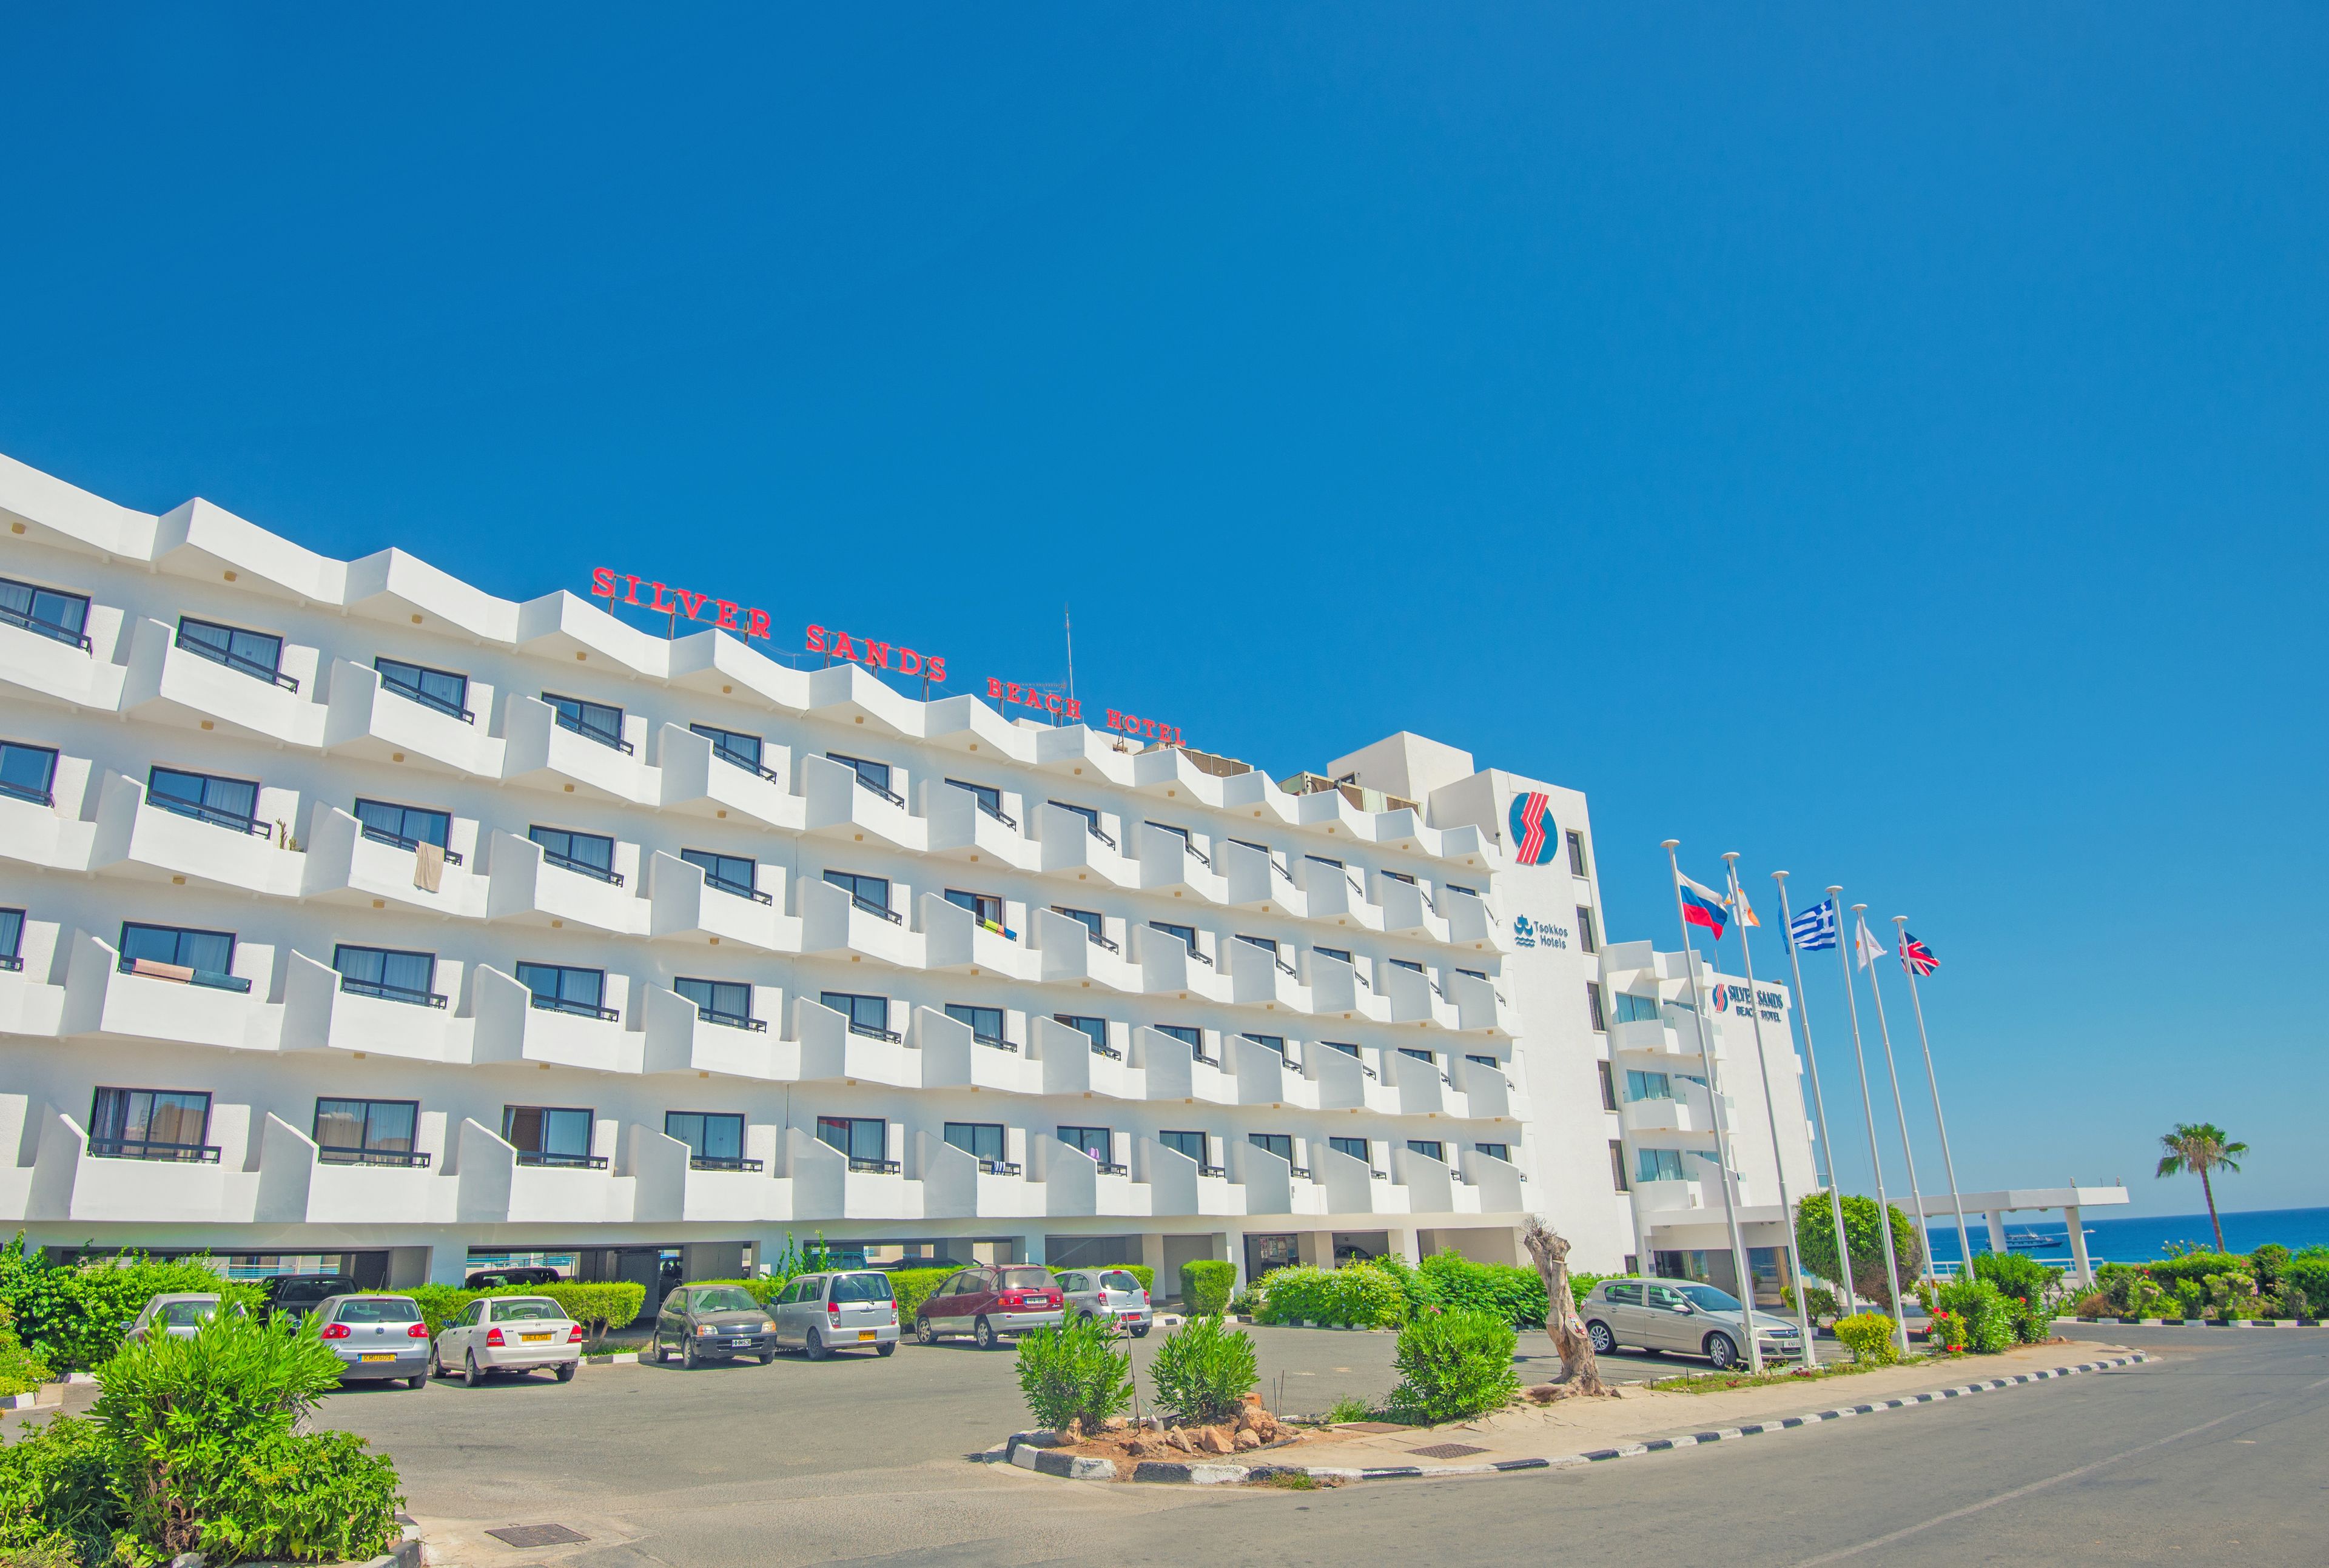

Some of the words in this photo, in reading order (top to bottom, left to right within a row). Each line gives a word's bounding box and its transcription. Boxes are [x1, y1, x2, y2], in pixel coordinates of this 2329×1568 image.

[591, 567, 771, 639] SILVER
[806, 625, 947, 682] SANDS
[987, 677, 1082, 719] BEACH
[1106, 708, 1186, 746] HOTEL
[1534, 920, 1568, 938] Tsokkos
[1540, 934, 1567, 950] Hotels
[1728, 985, 1752, 1003] SILVE
[1756, 990, 1784, 1010] SANDS
[1736, 1005, 1753, 1017] BEAC
[1761, 1010, 1782, 1023] HOTEL
